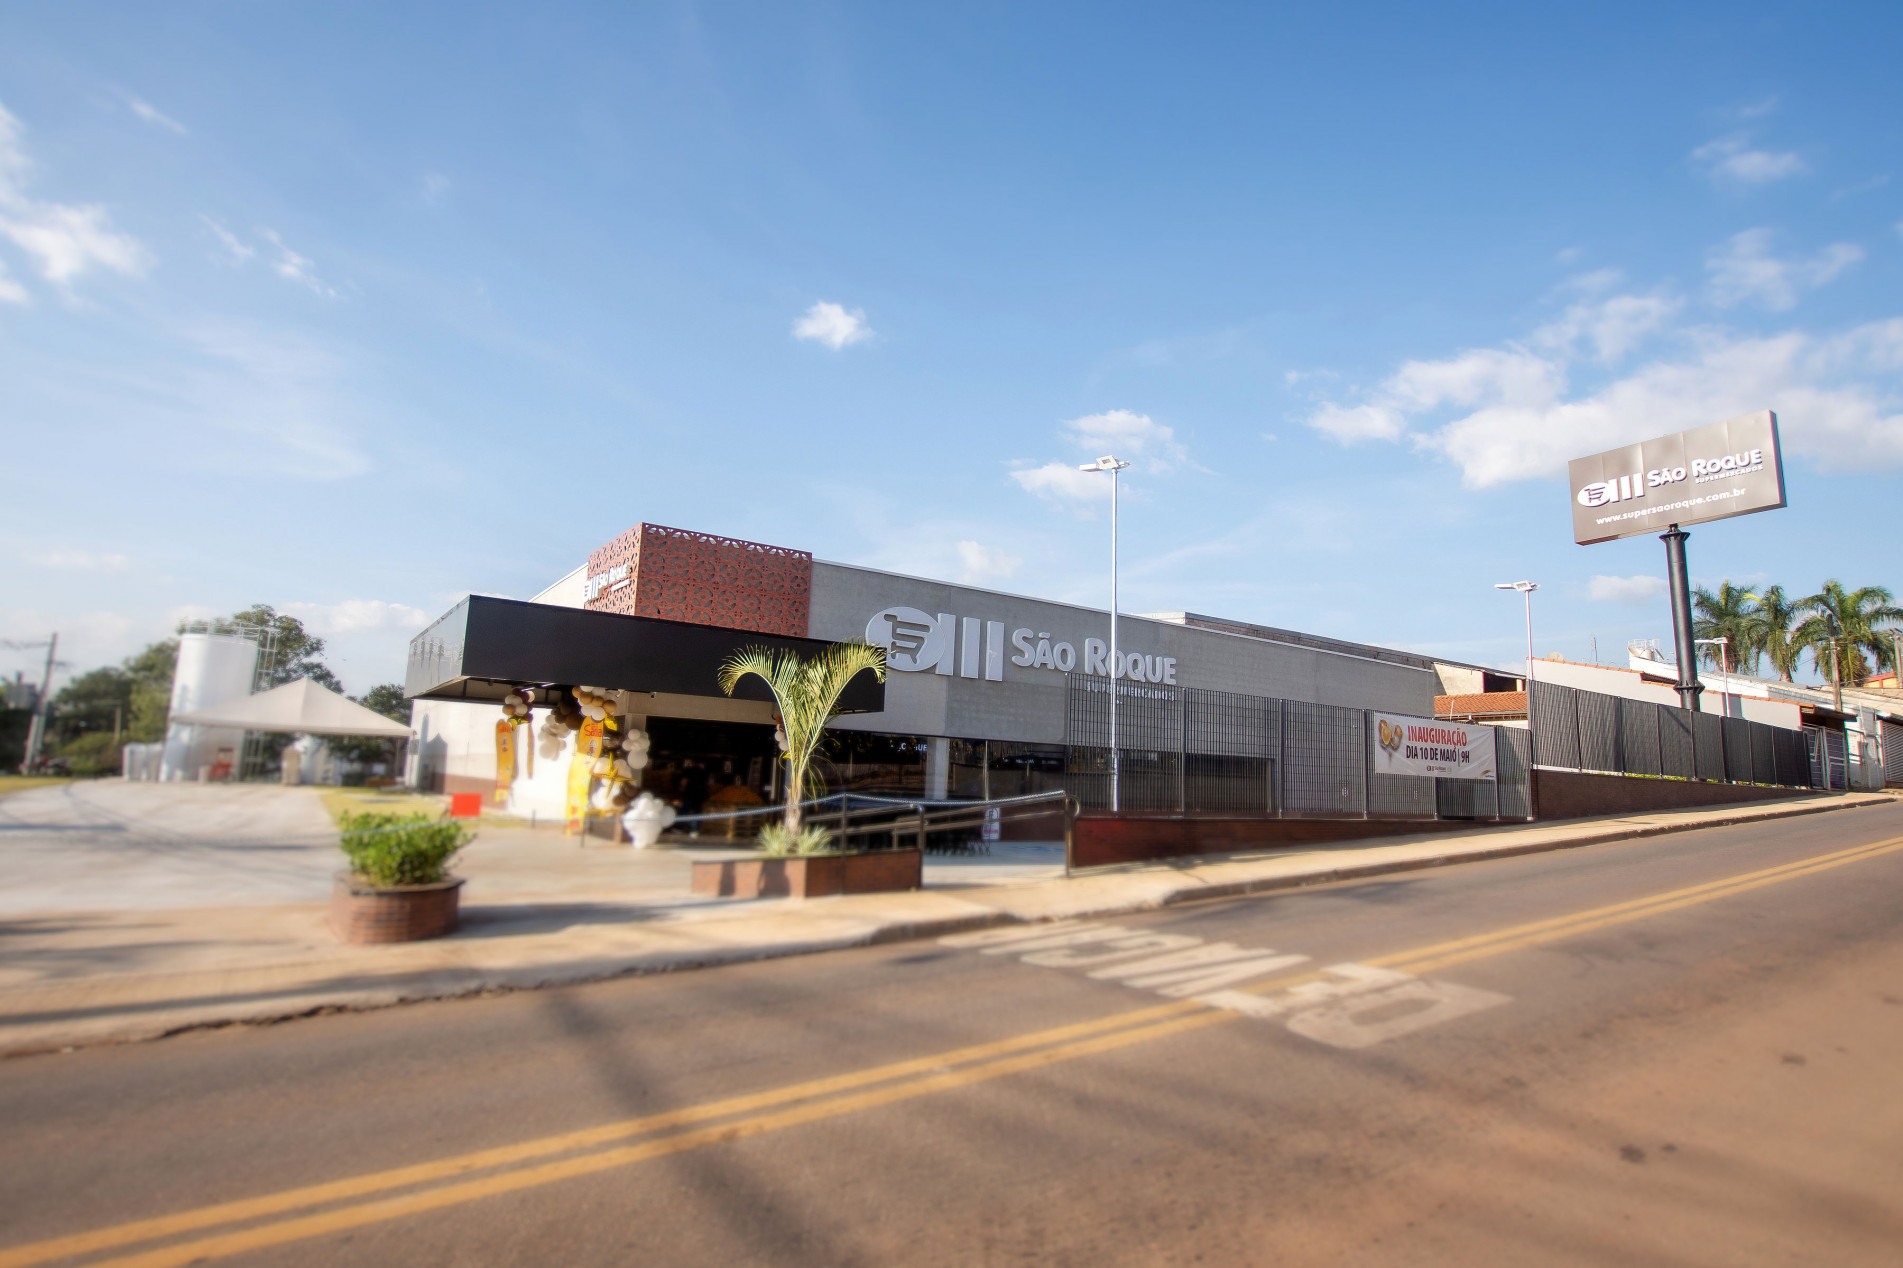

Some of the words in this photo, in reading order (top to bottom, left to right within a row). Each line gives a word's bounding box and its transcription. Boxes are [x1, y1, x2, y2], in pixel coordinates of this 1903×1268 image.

[1647, 467, 1687, 488] SÃO
[1691, 449, 1763, 477] ROQUE
[1596, 487, 1747, 525] www.supersaoroque.com.br
[1011, 627, 1077, 672] SÃO
[1085, 637, 1177, 685] ROQUE
[1406, 745, 1418, 759] DIA
[1420, 746, 1428, 760] 10
[1430, 747, 1438, 760] DE
[1440, 748, 1456, 763] MAIO
[1461, 750, 1470, 763] 9H
[1407, 725, 1467, 750] INAUGURAÇÃO
[937, 919, 1514, 1049] DEVAGAR
